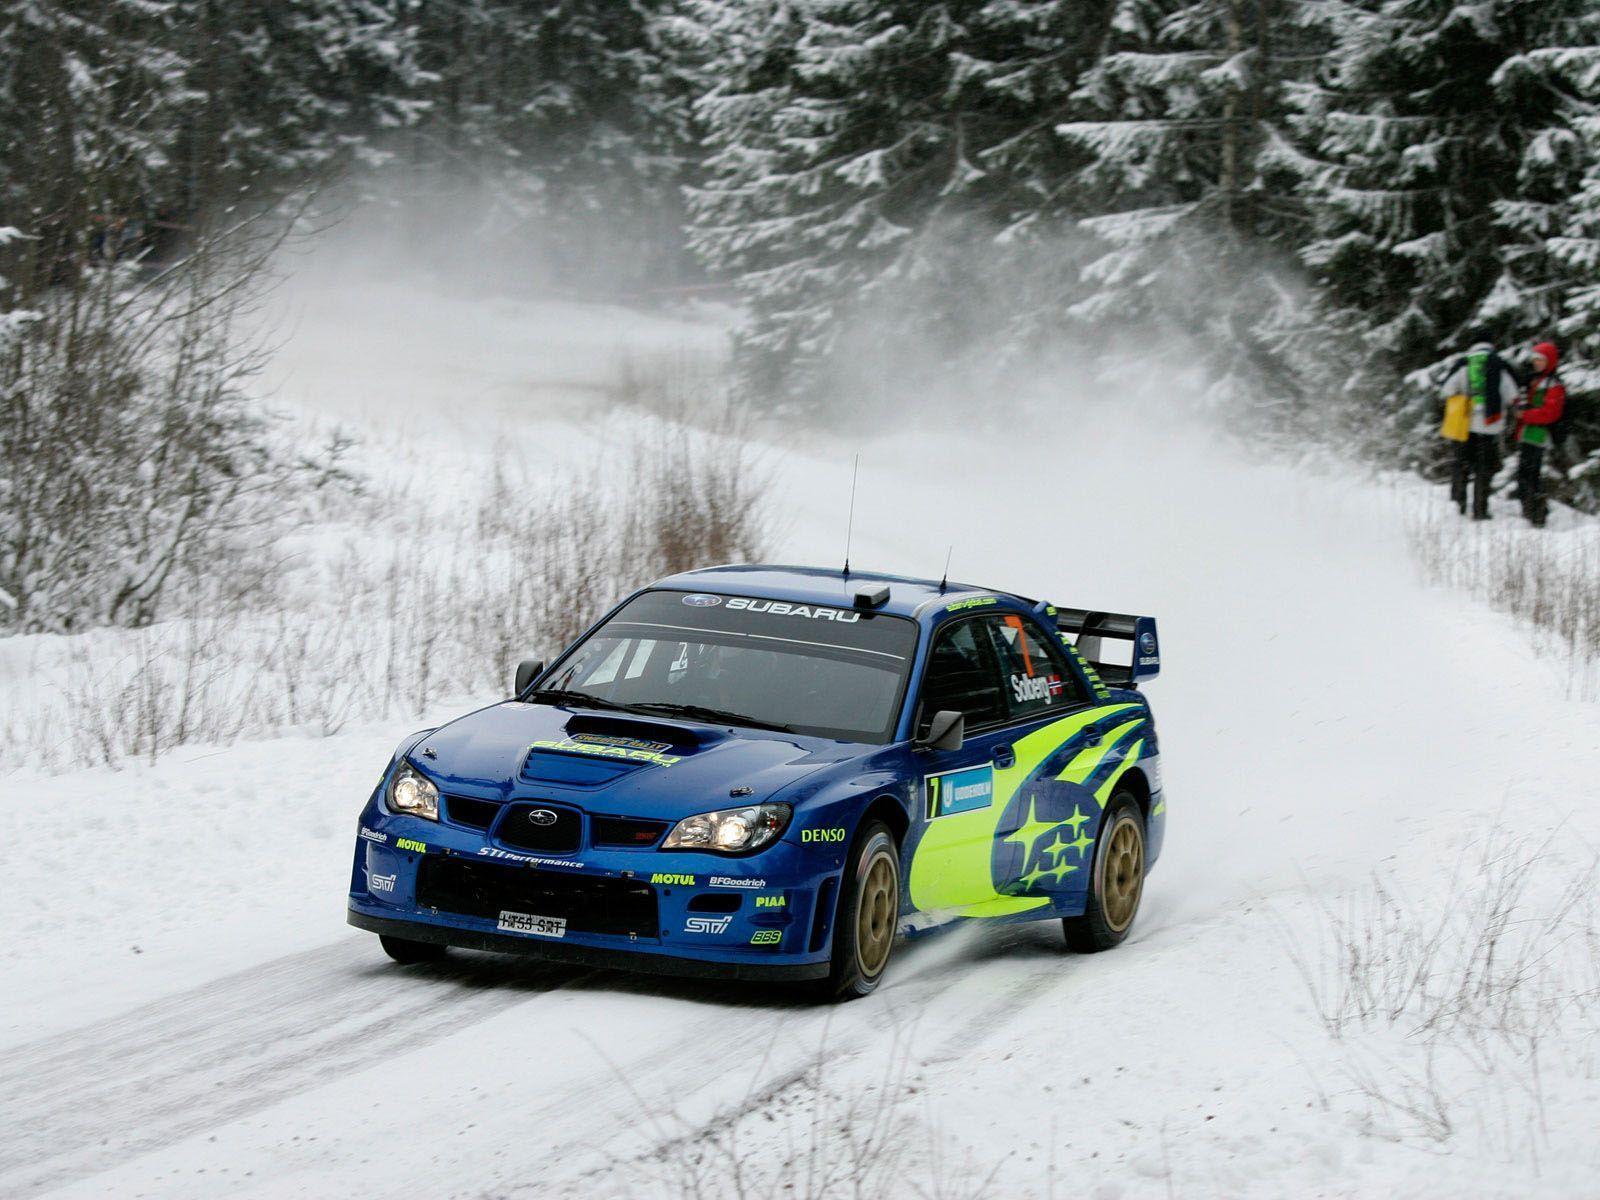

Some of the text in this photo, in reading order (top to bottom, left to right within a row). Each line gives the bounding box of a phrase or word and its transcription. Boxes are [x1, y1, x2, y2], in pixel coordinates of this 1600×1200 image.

[725, 599, 861, 623] SUBARU
[1003, 615, 1035, 678] 7
[1011, 673, 1051, 705] Solberg
[527, 741, 682, 766] SUBARU
[930, 777, 939, 818] 7
[801, 828, 846, 842] DENSO
[396, 838, 427, 853] MOTUL
[477, 847, 584, 868] STI Performance
[651, 873, 695, 885] MOTUL
[709, 876, 766, 889] BFGoodrich
[756, 896, 786, 907] PIAA
[751, 930, 782, 944] BBS
